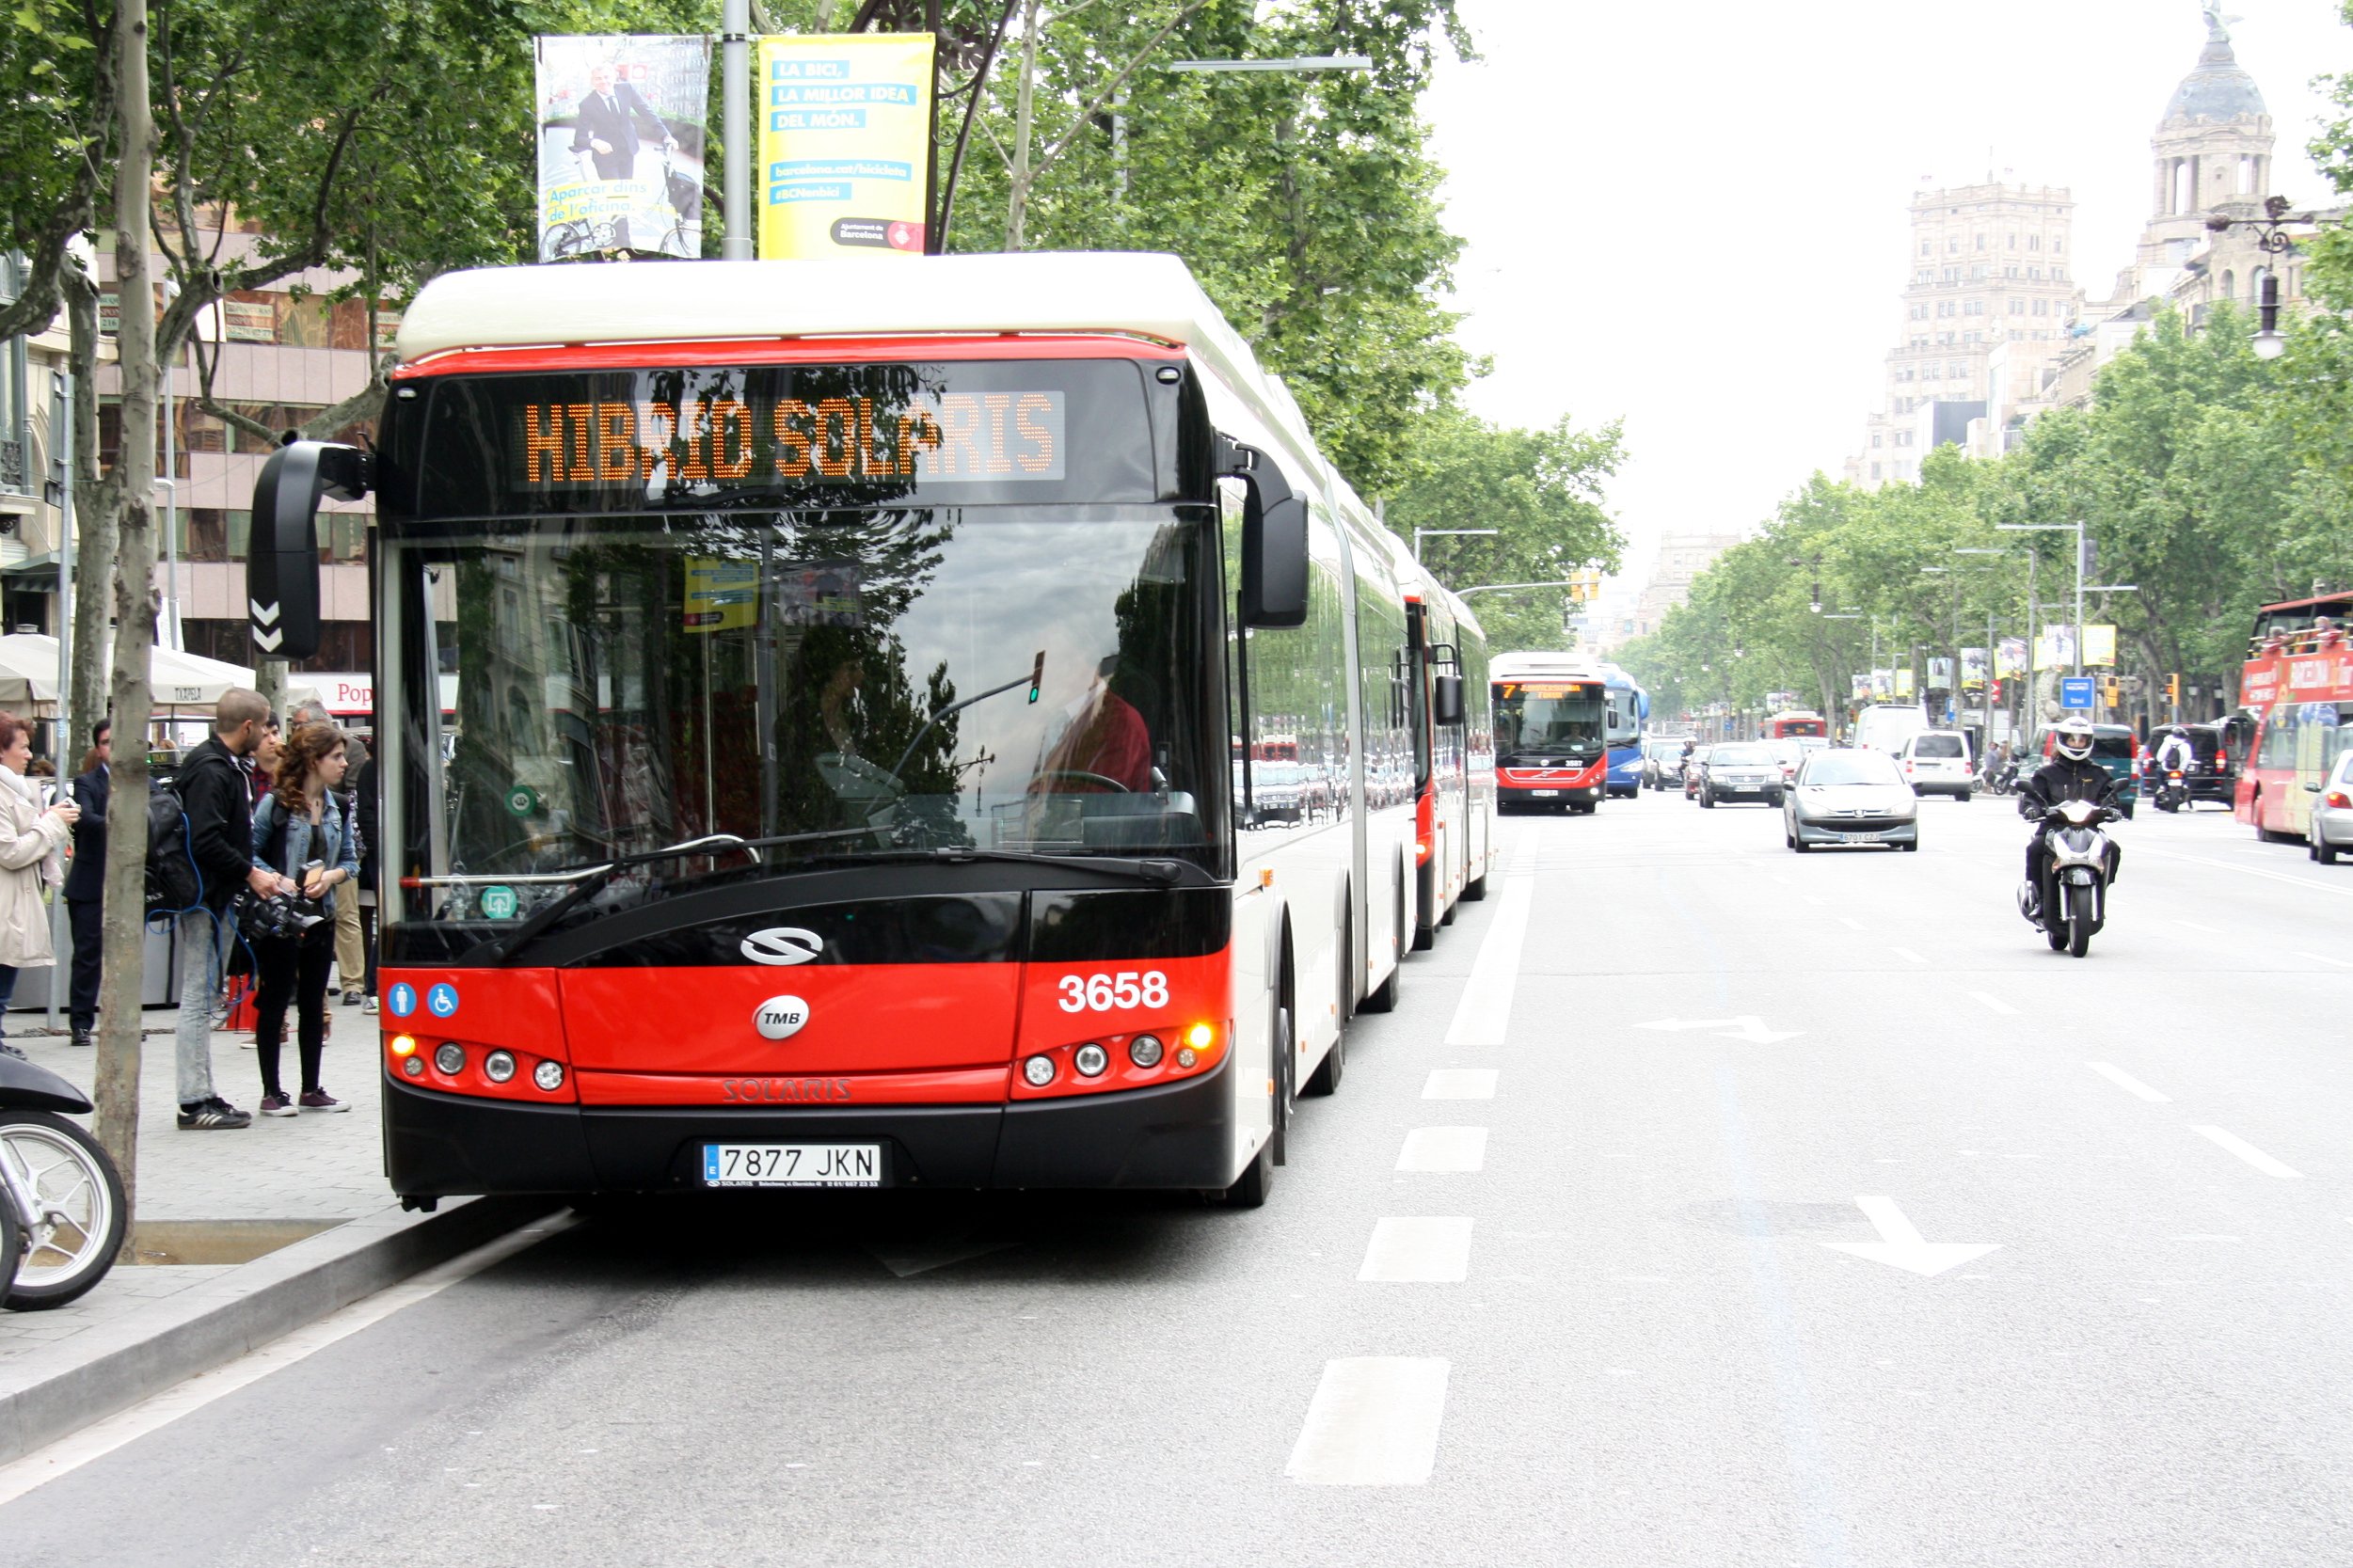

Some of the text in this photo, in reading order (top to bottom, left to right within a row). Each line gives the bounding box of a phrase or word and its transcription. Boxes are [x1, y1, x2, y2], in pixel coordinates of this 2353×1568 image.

[779, 62, 843, 77] LA BICI,
[778, 87, 910, 103] LA MILLOR IDEA
[777, 109, 860, 129] DEL MÓN.
[775, 164, 907, 178] barcelona.cat/bicicleta
[549, 181, 647, 205] Aparcar dins
[549, 206, 564, 222] de
[840, 223, 875, 231] Ajuntament
[840, 230, 884, 241] Barcelona
[526, 393, 1054, 482] HIBRID SOLARIS
[1502, 684, 1517, 699] 7
[1058, 970, 1169, 1013] 3658
[764, 1012, 801, 1024] TMB
[723, 1079, 851, 1101] SOLARIS
[708, 1149, 872, 1177] E 7877 JKN
